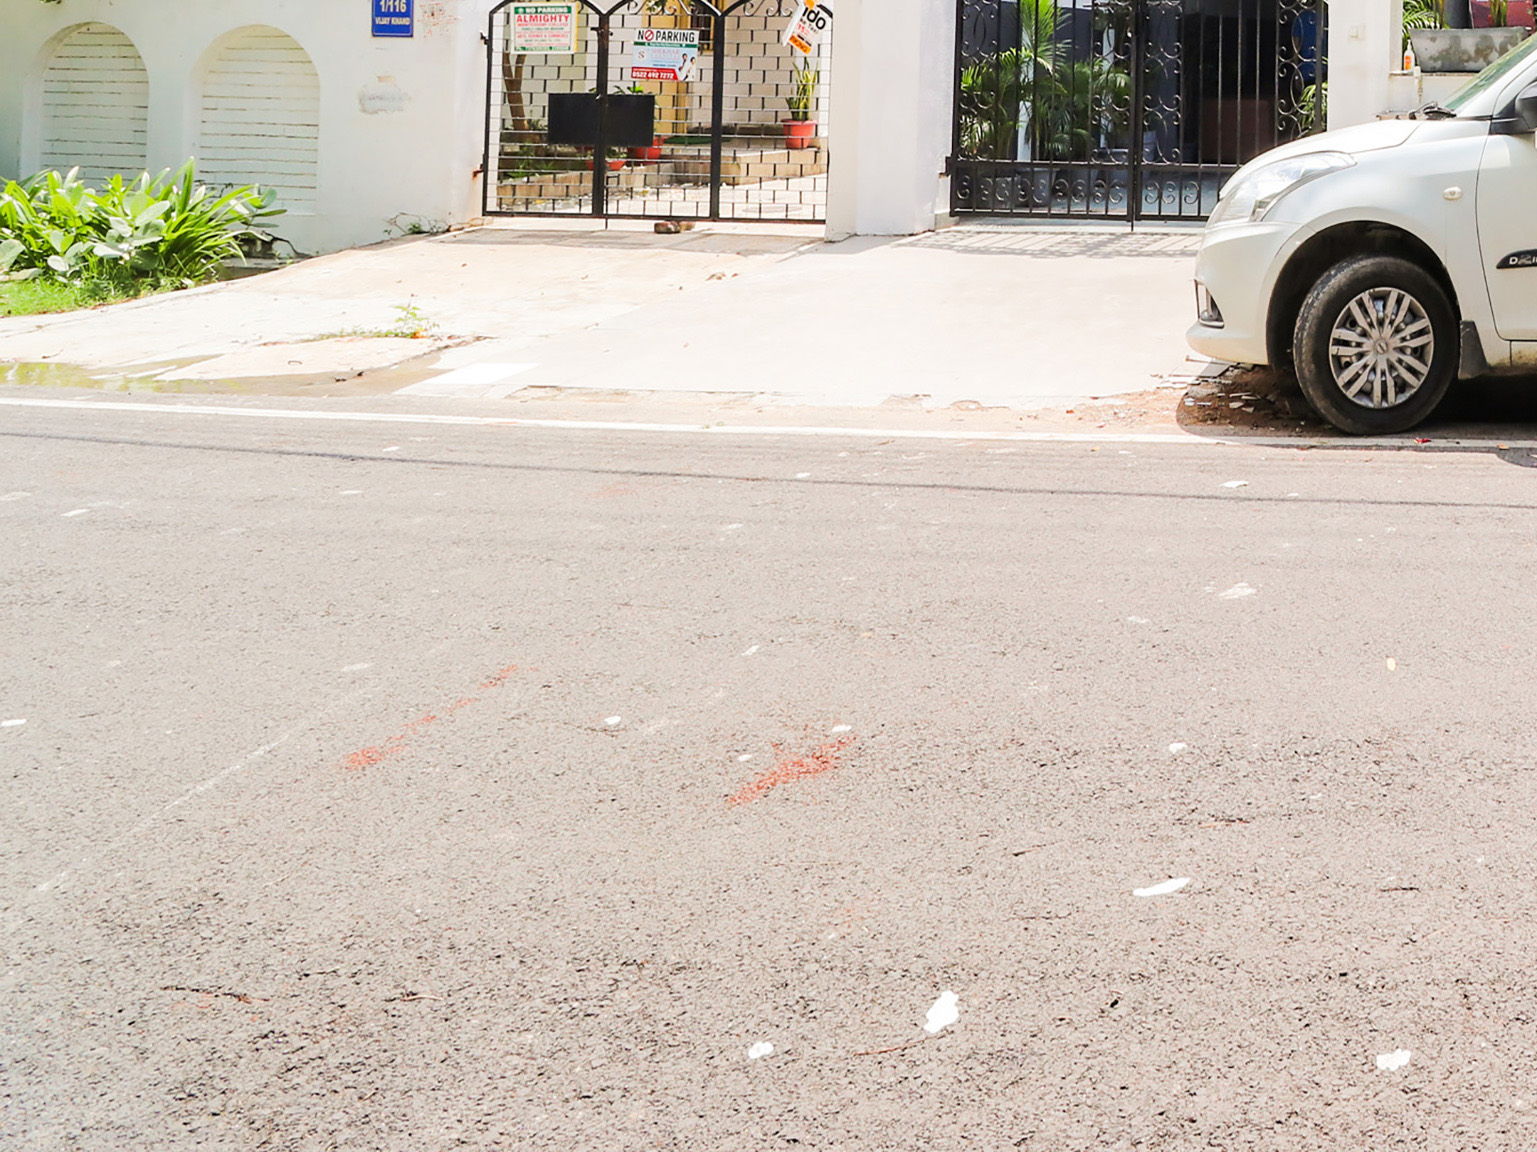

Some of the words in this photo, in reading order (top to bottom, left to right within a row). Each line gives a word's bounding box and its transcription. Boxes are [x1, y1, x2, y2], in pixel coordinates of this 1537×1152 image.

[379, 0, 407, 13] 1/116
[516, 14, 569, 23] ALMIGHTY
[655, 30, 695, 43] PARKING
